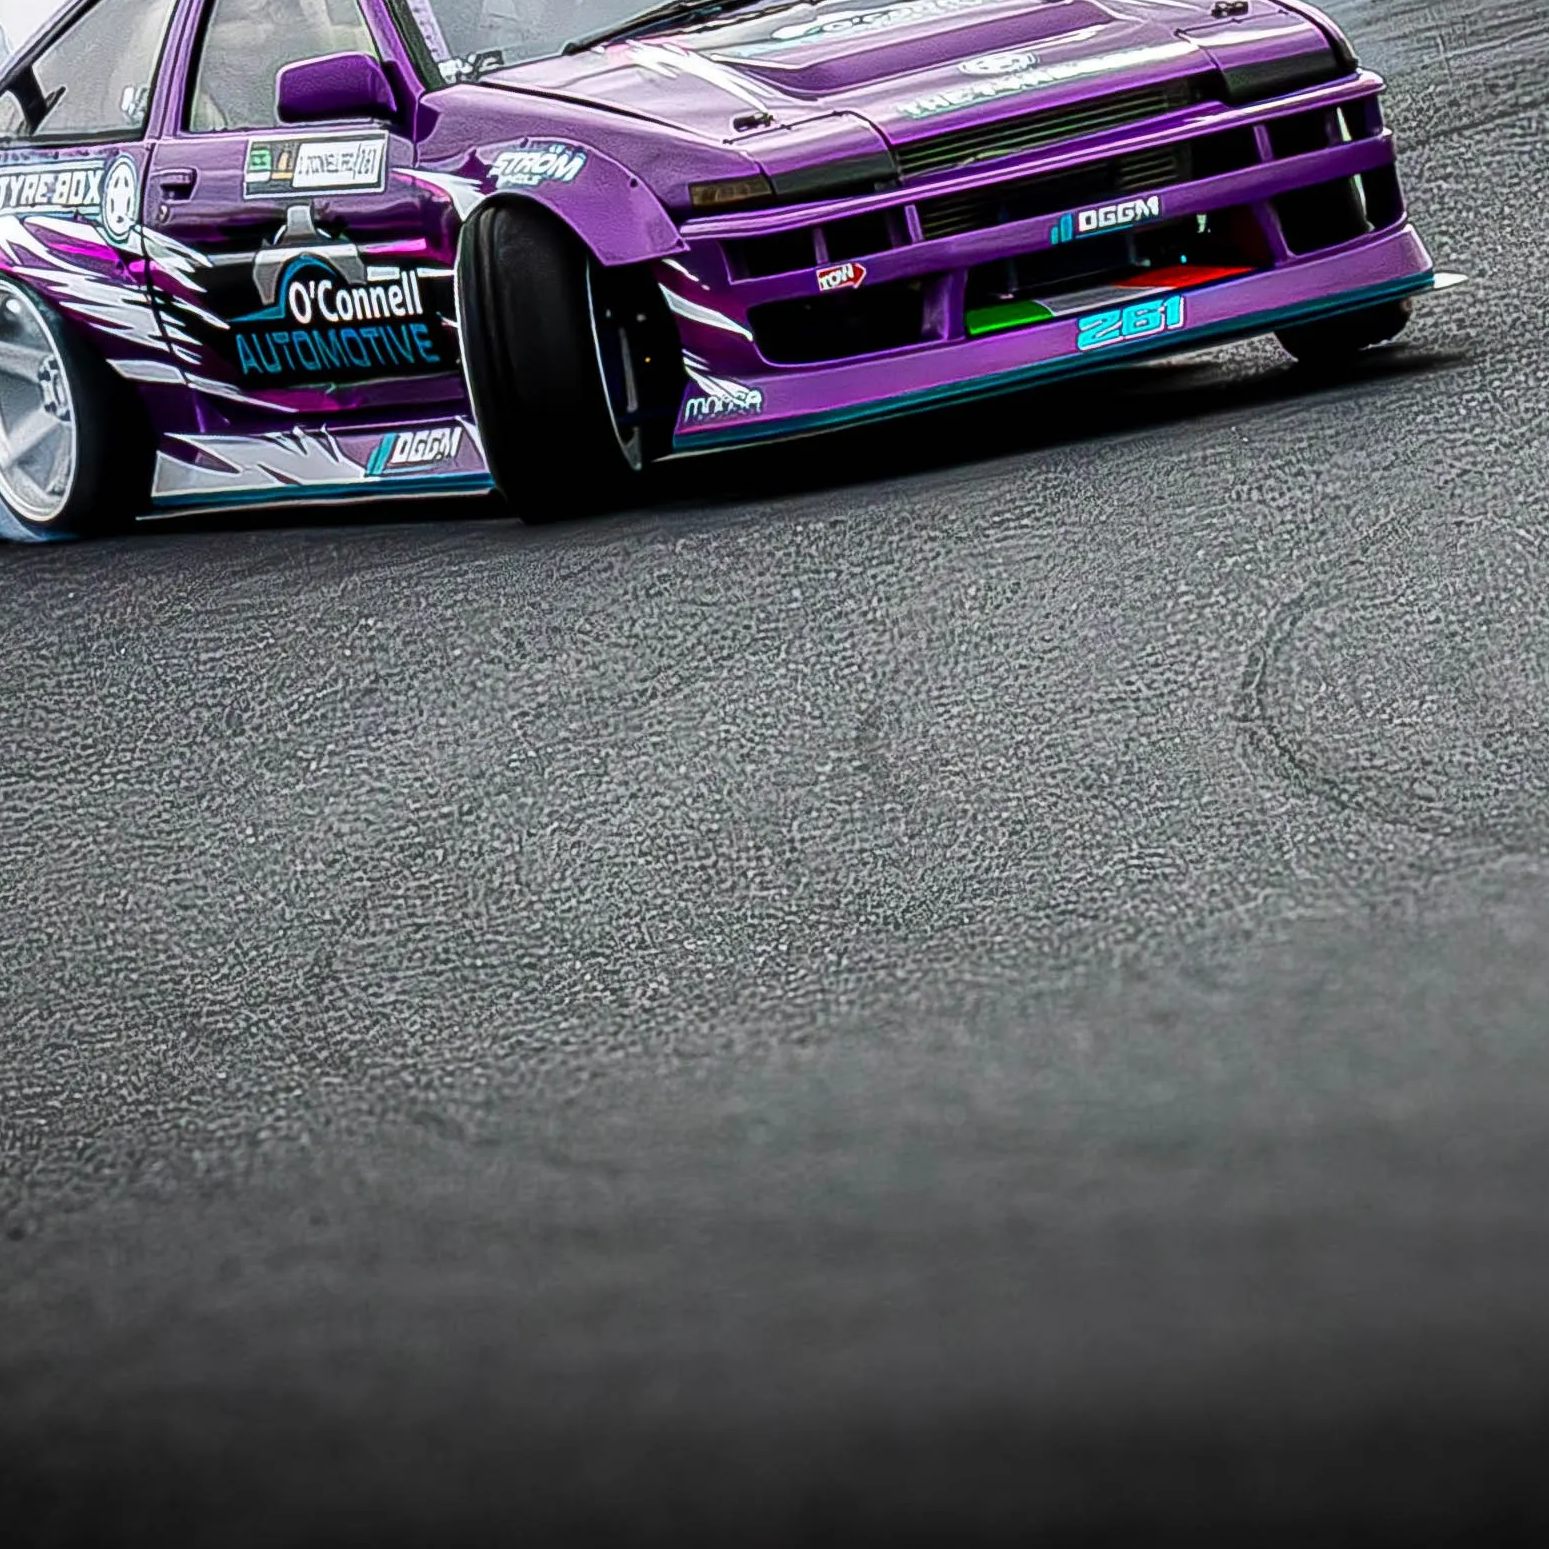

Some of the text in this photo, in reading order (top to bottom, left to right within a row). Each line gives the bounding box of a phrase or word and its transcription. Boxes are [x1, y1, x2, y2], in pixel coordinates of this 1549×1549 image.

[53, 169, 104, 206] BOX
[288, 268, 424, 325] O'Connell
[1076, 294, 1185, 351] 261
[235, 323, 441, 376] AUTOMOTIVE
